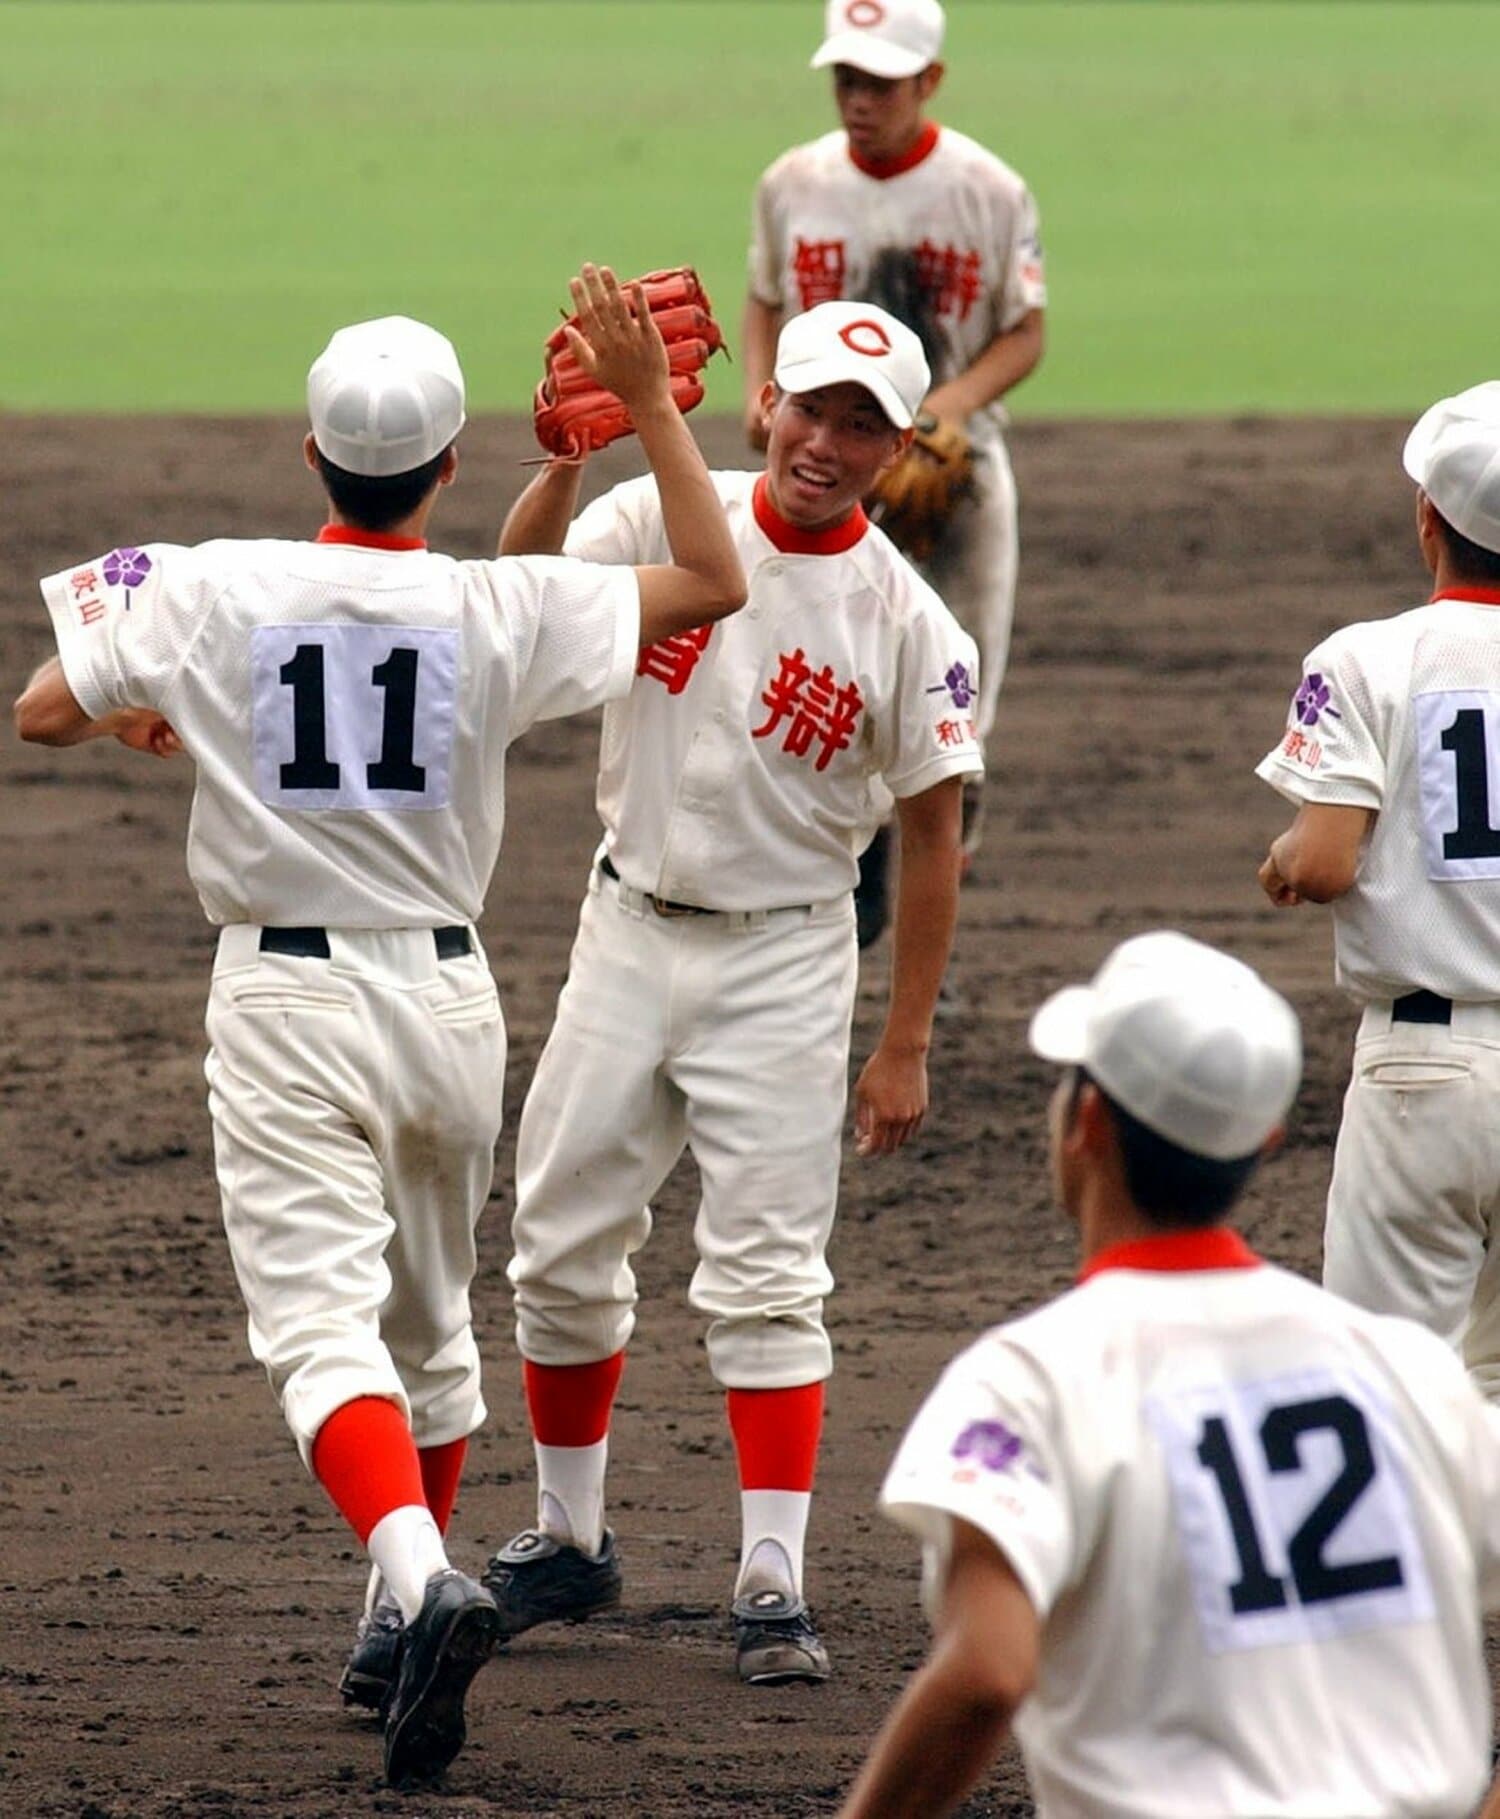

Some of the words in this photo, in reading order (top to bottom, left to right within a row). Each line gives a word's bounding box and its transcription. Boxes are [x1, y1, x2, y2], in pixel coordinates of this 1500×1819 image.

[838, 320, 892, 356] C
[280, 644, 426, 793] 11
[1196, 1395, 1405, 1614] 12
